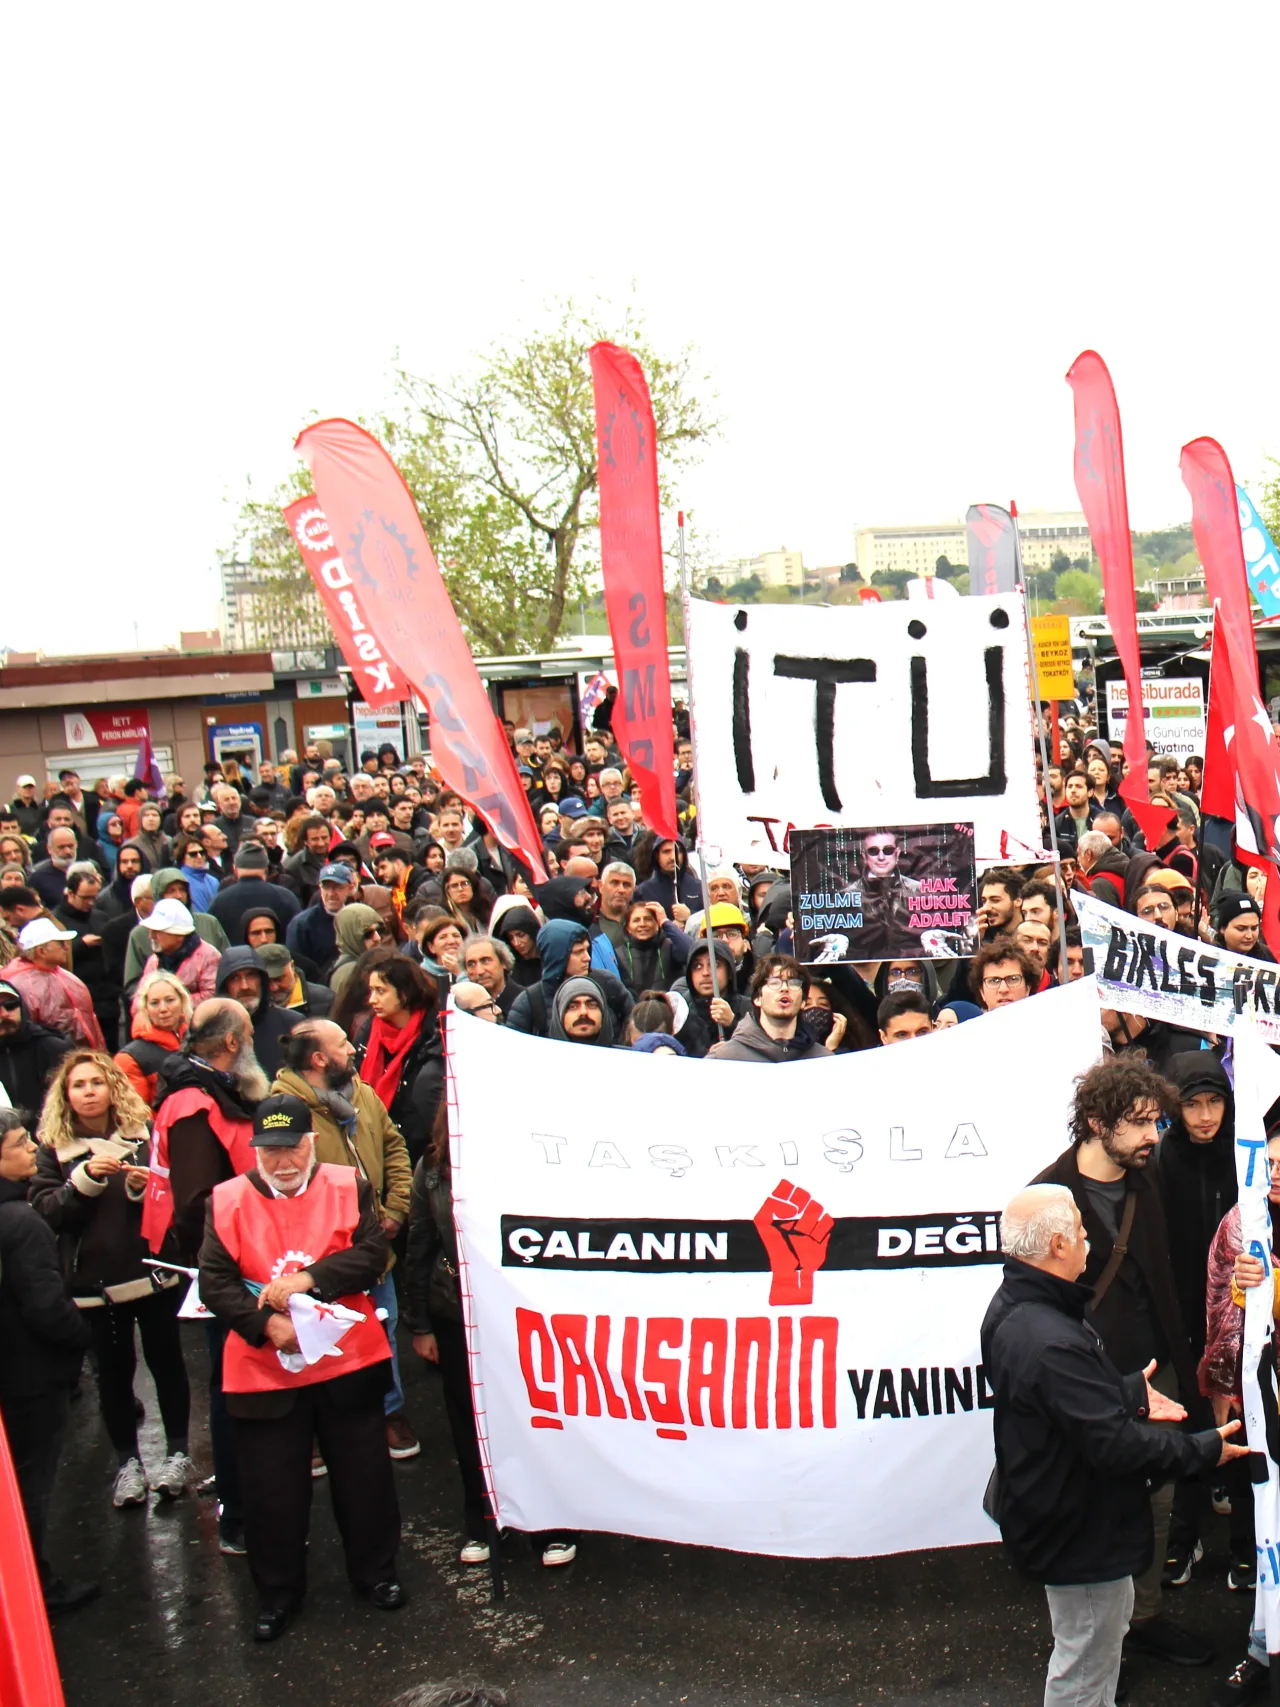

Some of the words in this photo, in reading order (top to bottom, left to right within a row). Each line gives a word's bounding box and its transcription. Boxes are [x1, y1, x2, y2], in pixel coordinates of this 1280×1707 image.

[1111, 682, 1201, 701] hesiburada
[732, 608, 1010, 813] İTÜ
[920, 878, 957, 893] HAK
[800, 892, 862, 909] ZULME
[908, 894, 971, 911] HUKUK
[802, 913, 863, 929] DEVAM
[908, 912, 971, 928] ADALET
[532, 1123, 989, 1179] TAŞKIŞLA
[508, 1228, 728, 1265] ÇALANIN
[877, 1211, 999, 1258] DEĞİ
[515, 1306, 838, 1441] ÇALIŞANIN
[847, 1364, 994, 1420] YANIND
